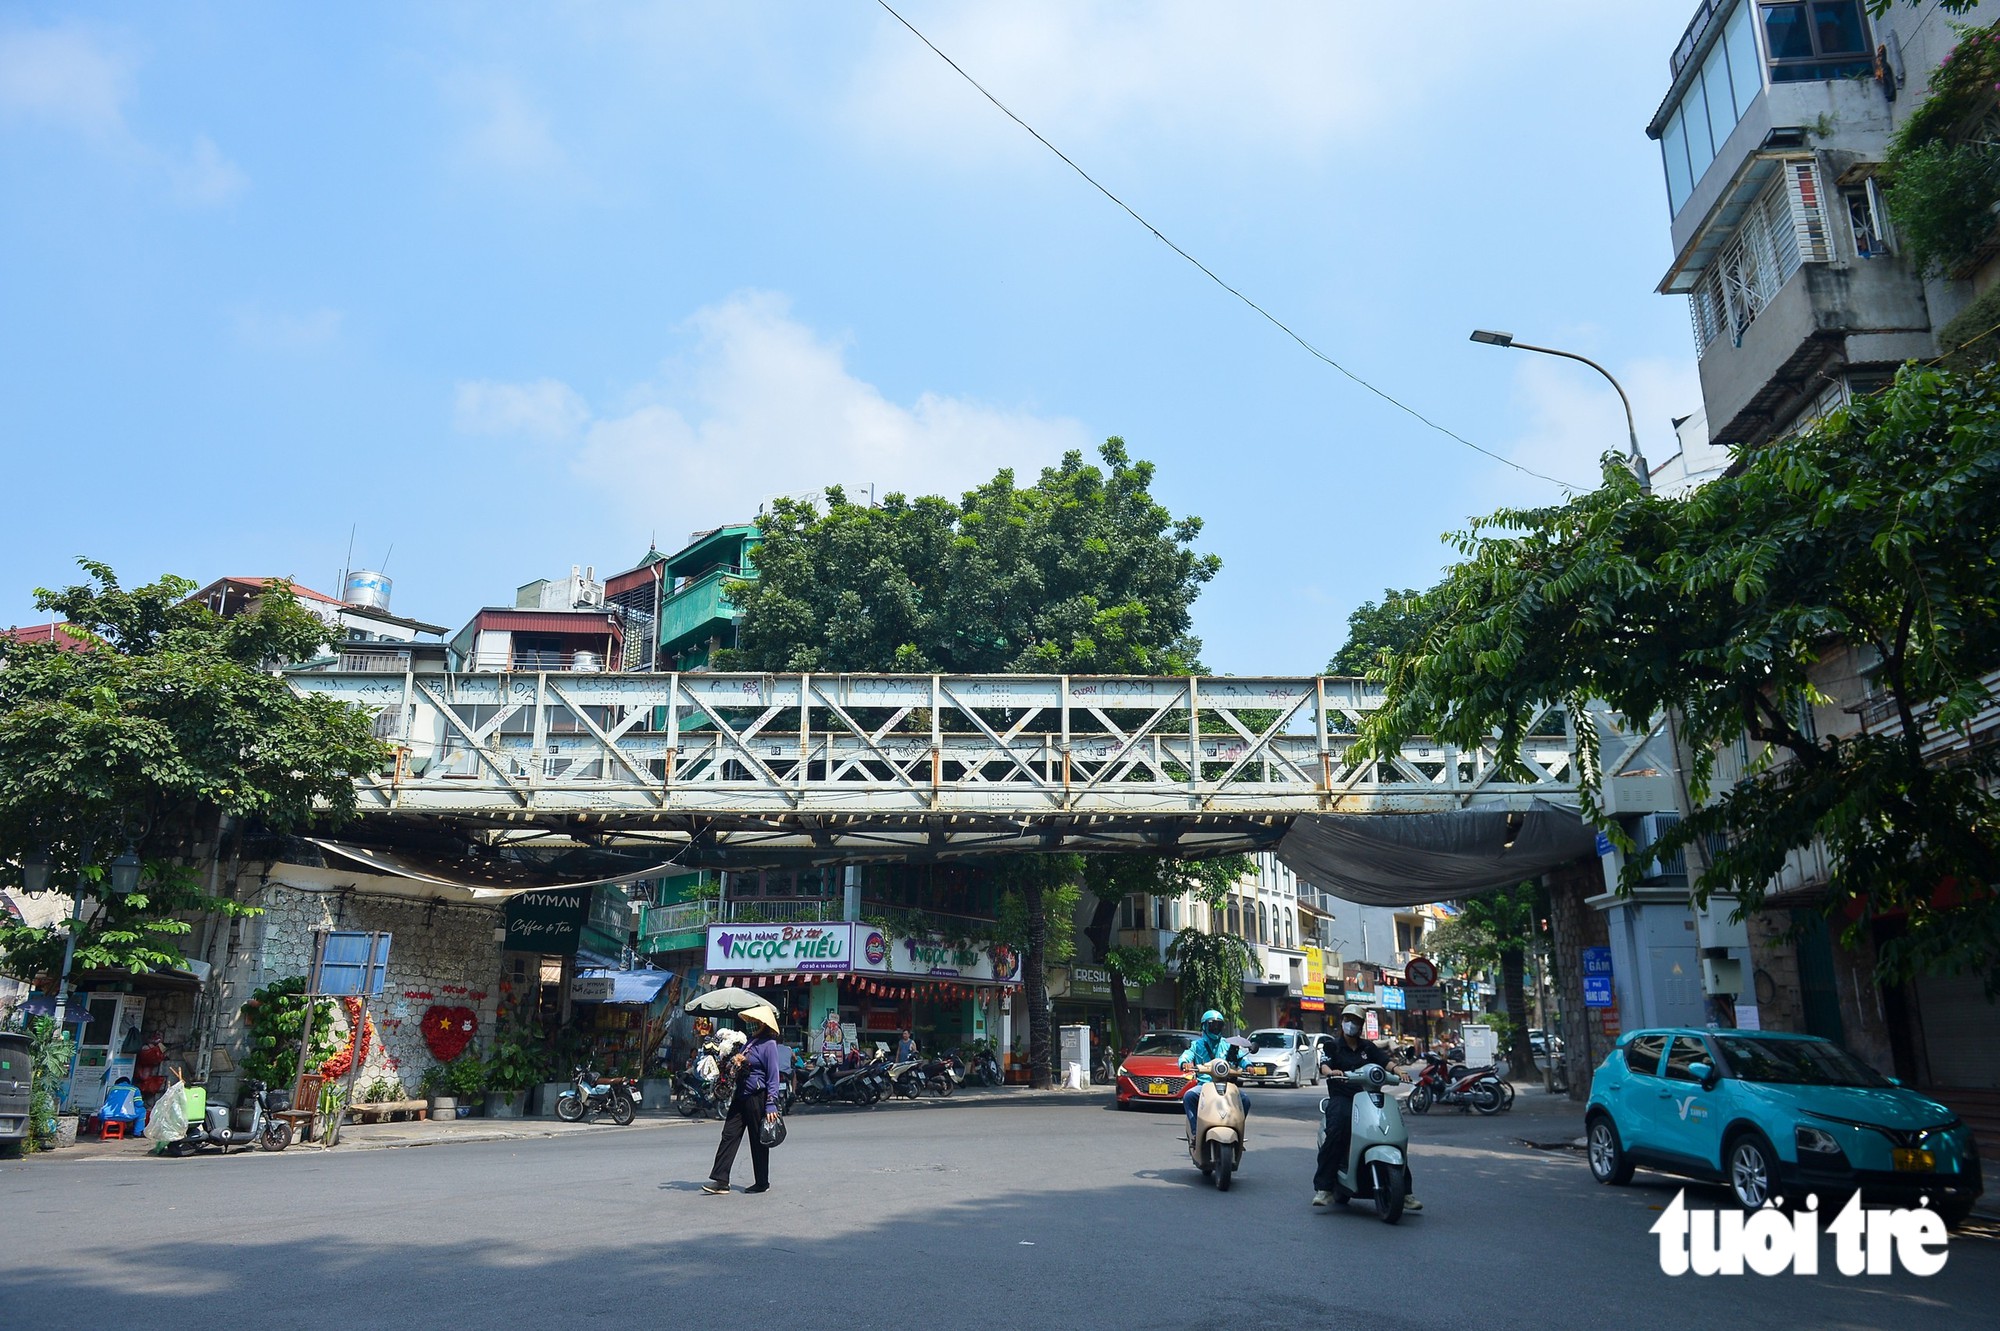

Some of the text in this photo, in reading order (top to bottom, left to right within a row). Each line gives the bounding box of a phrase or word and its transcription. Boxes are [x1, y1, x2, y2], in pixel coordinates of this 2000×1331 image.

[523, 894, 580, 908] MYMAN
[511, 919, 573, 936] Coffee & Tea
[735, 931, 752, 940] NHÀ
[755, 931, 779, 940] HÀNG
[731, 940, 790, 962] NGỌC
[794, 932, 843, 958] HIẾU
[1075, 968, 1105, 983] FRESH
